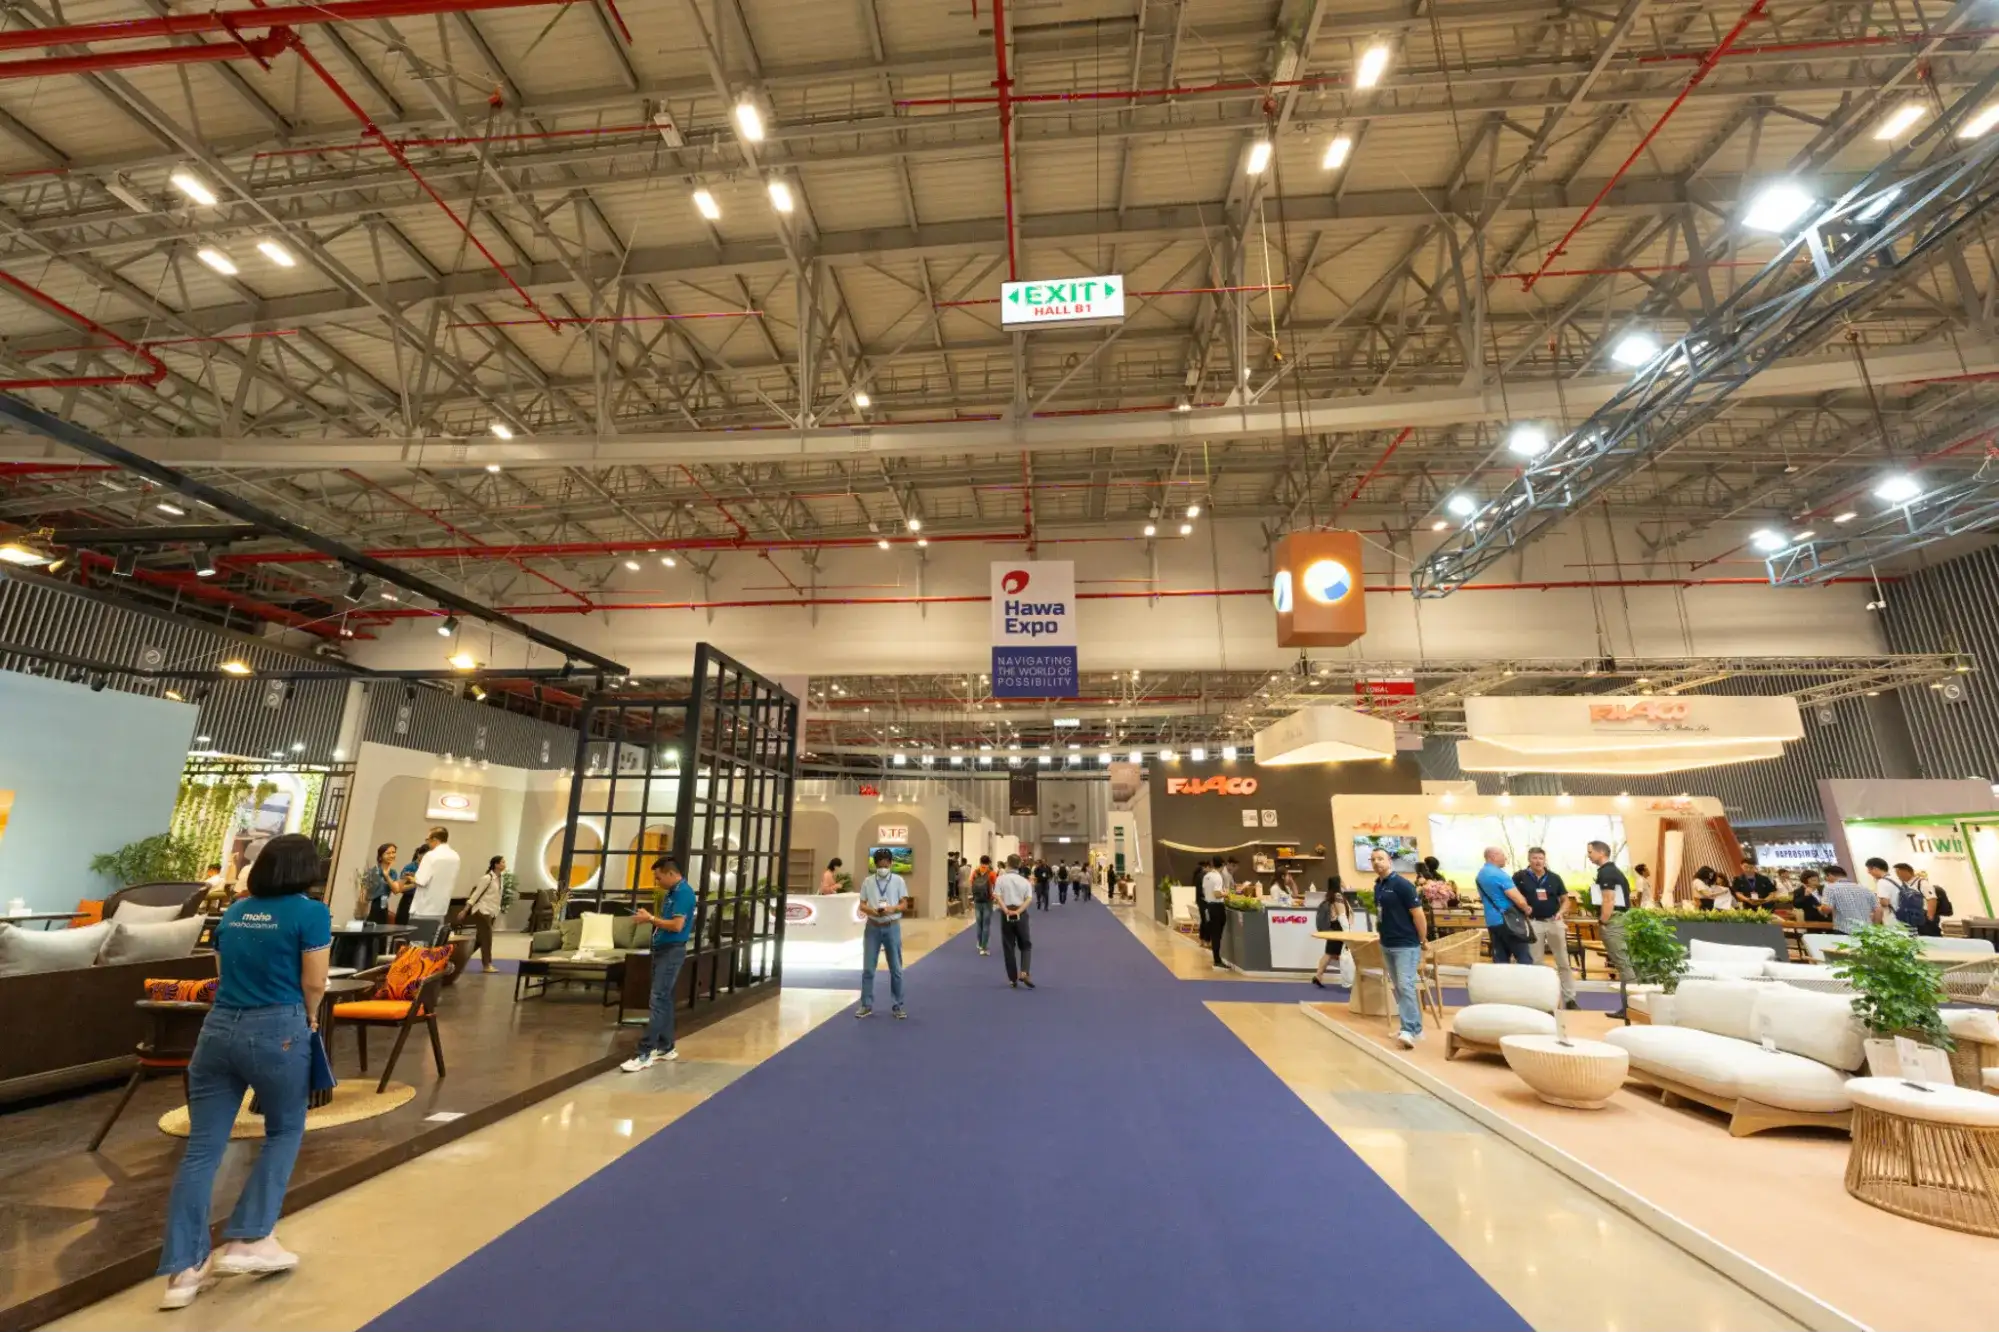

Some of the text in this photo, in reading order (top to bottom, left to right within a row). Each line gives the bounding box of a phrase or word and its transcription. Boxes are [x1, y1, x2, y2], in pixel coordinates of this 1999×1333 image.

[1025, 282, 1098, 305] EXIT
[1034, 304, 1092, 316] HALL B1
[1005, 600, 1065, 616] Hawa
[1005, 618, 1058, 637] Expo
[997, 656, 1072, 666] NAVIGATING
[998, 667, 1072, 676] THE WORLD OF
[998, 677, 1072, 687] POSSIBILITY
[242, 912, 272, 921] moho
